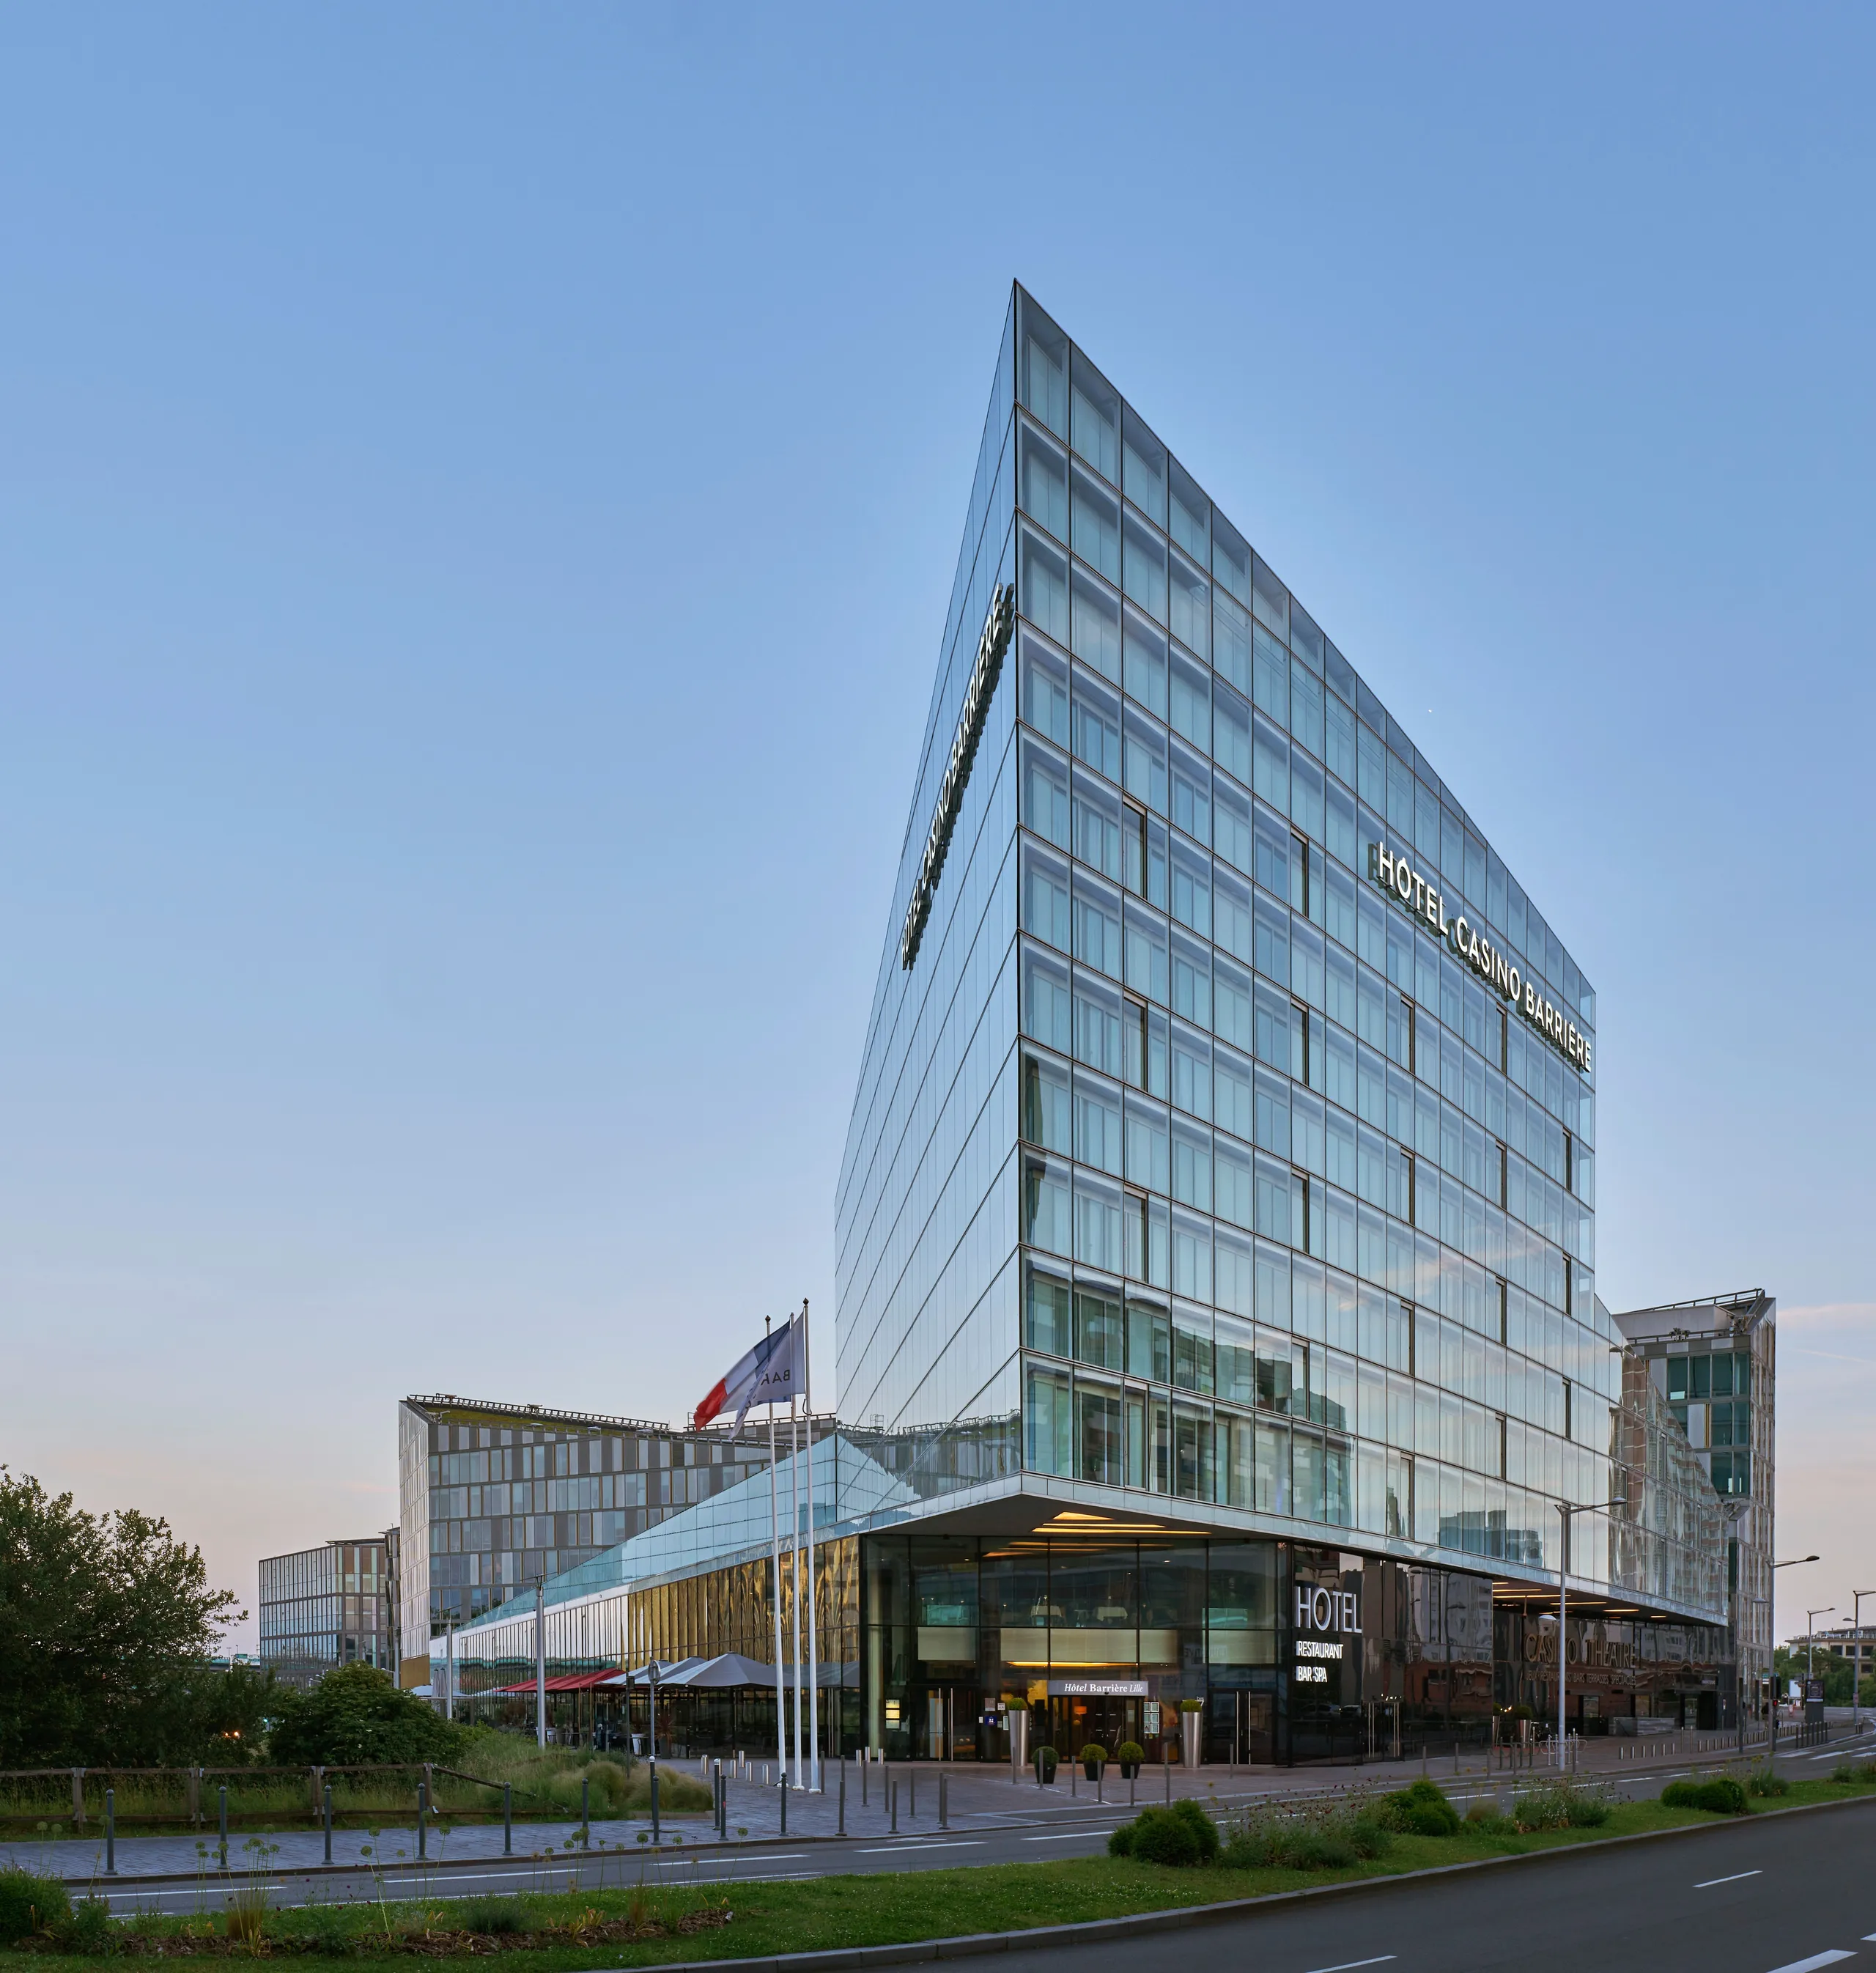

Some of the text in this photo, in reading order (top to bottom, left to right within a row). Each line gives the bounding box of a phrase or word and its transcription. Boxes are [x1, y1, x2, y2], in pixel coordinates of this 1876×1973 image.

[922, 769, 952, 890] CASINO
[1456, 916, 1521, 1001] CASINO
[1525, 981, 1592, 1073] BARRIÈRE
[1295, 1586, 1362, 1633] HOTEL
[1296, 1640, 1344, 1659] RESTAURANT
[1526, 1634, 1577, 1664] CASIO
[1064, 1683, 1143, 1692] Hôtel Barrière Lille
[1296, 1665, 1328, 1683] BAR SPA
